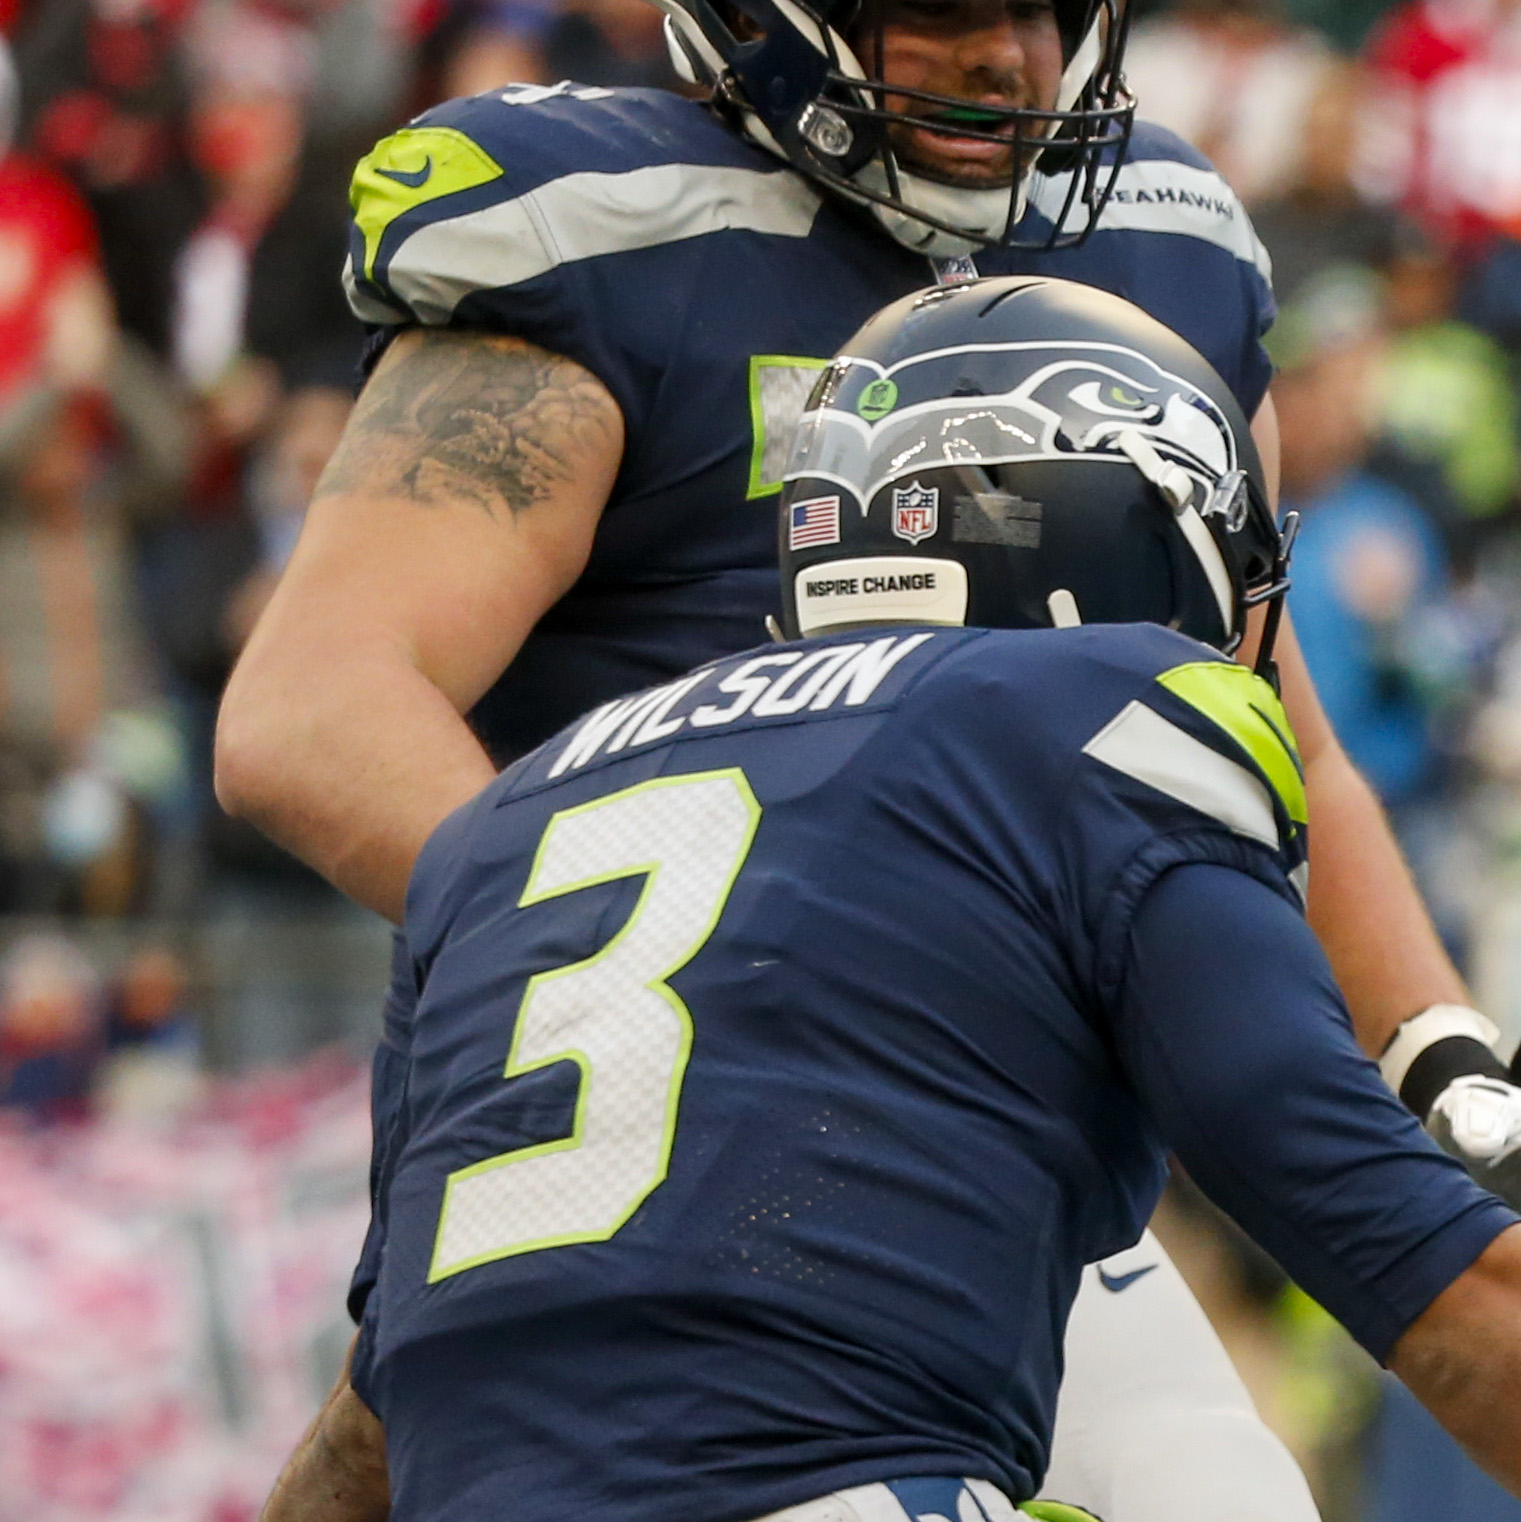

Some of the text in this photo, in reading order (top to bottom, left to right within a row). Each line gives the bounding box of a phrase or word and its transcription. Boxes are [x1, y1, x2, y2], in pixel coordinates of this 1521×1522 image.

[899, 510, 931, 534] NFL
[806, 573, 936, 598] INSPIRE CHANGE
[546, 632, 937, 780] WILSON
[427, 767, 764, 1285] 3
